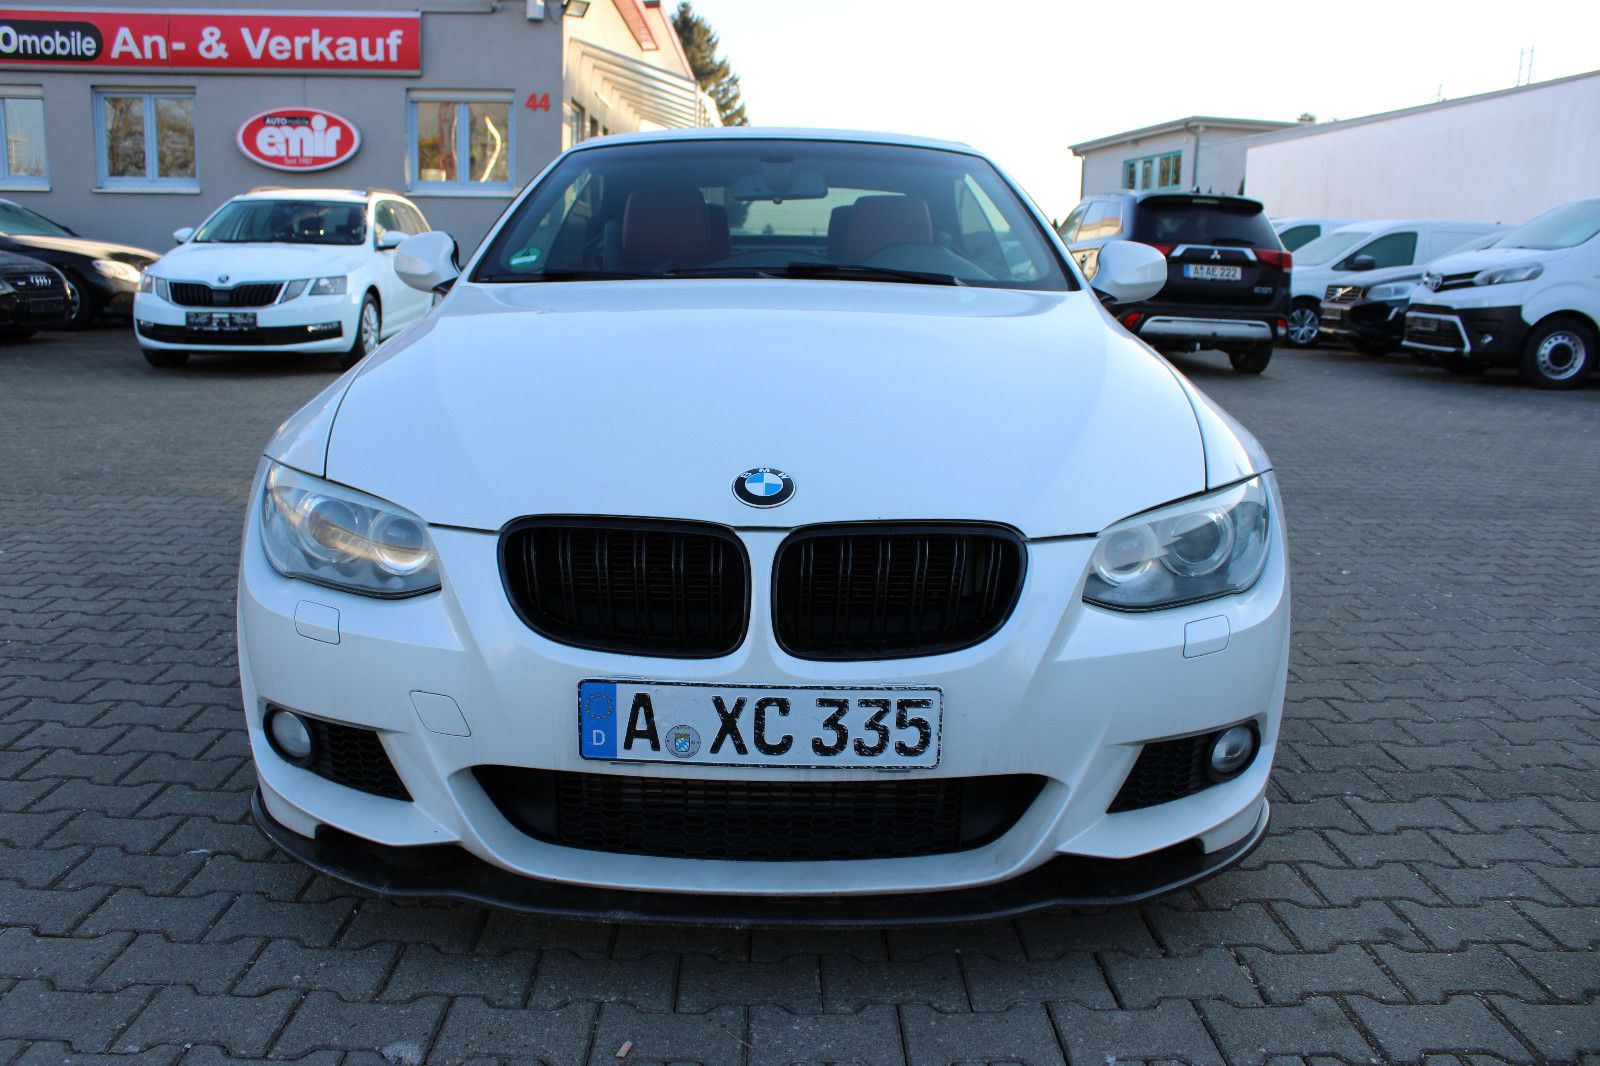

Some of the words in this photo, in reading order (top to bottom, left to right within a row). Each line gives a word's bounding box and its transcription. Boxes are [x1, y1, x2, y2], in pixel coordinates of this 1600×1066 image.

[110, 26, 186, 59] An-
[198, 26, 229, 59] &
[240, 27, 404, 62] Verkauf
[525, 92, 550, 112] 44
[256, 114, 342, 158] emir
[1220, 268, 1237, 277] 222
[592, 728, 606, 746] D
[624, 692, 661, 751] A
[709, 695, 794, 756] XC
[811, 697, 933, 757] 335
